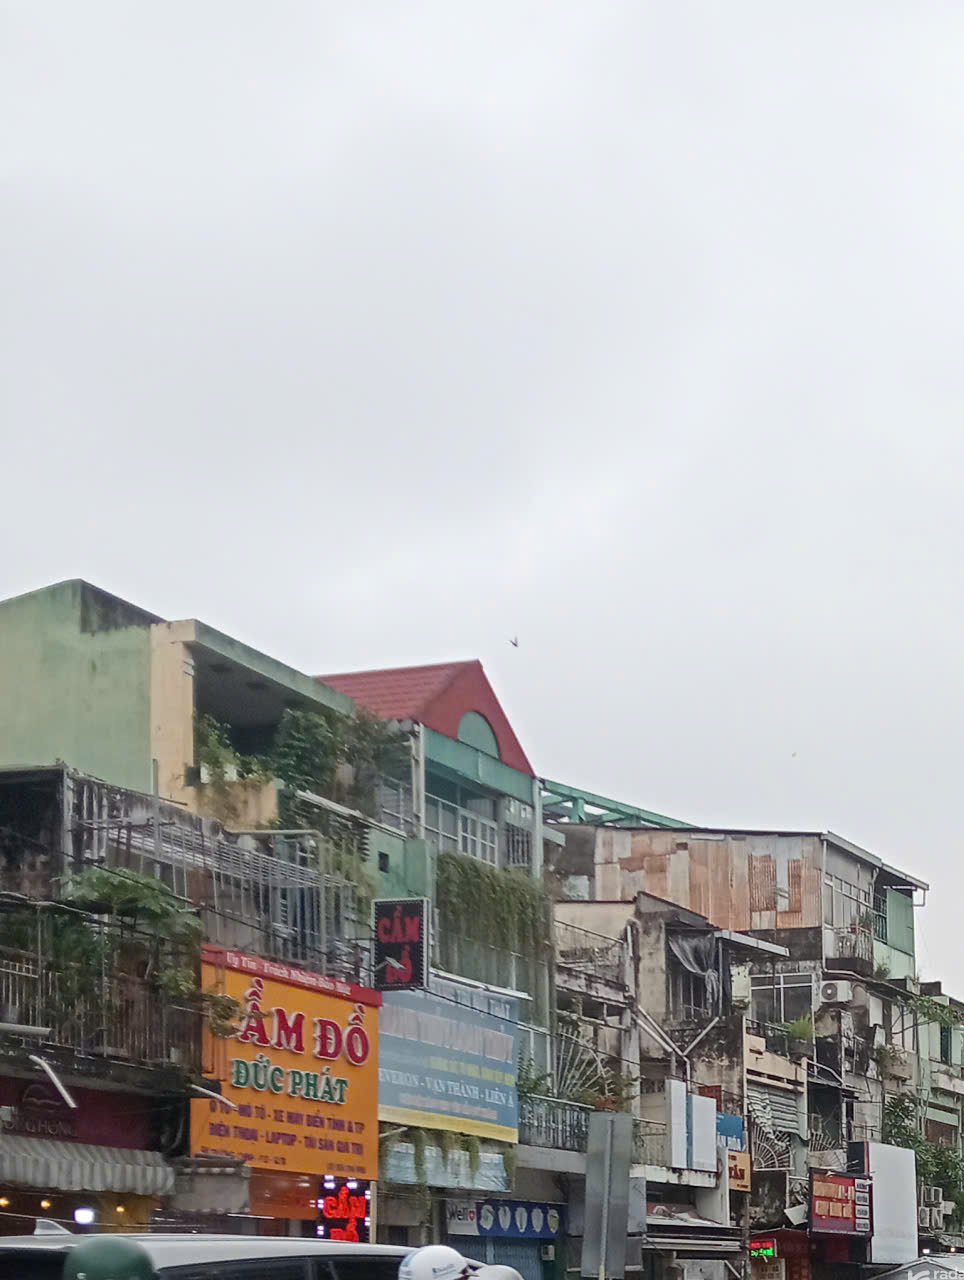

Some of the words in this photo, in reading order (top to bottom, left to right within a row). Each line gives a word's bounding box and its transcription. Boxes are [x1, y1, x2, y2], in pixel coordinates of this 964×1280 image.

[237, 977, 305, 1055] ẦM
[314, 1003, 370, 1066] ĐỒ
[232, 1053, 284, 1094] ĐỨC
[288, 1066, 349, 1104] PHÁT
[323, 1186, 366, 1218] CẦM
